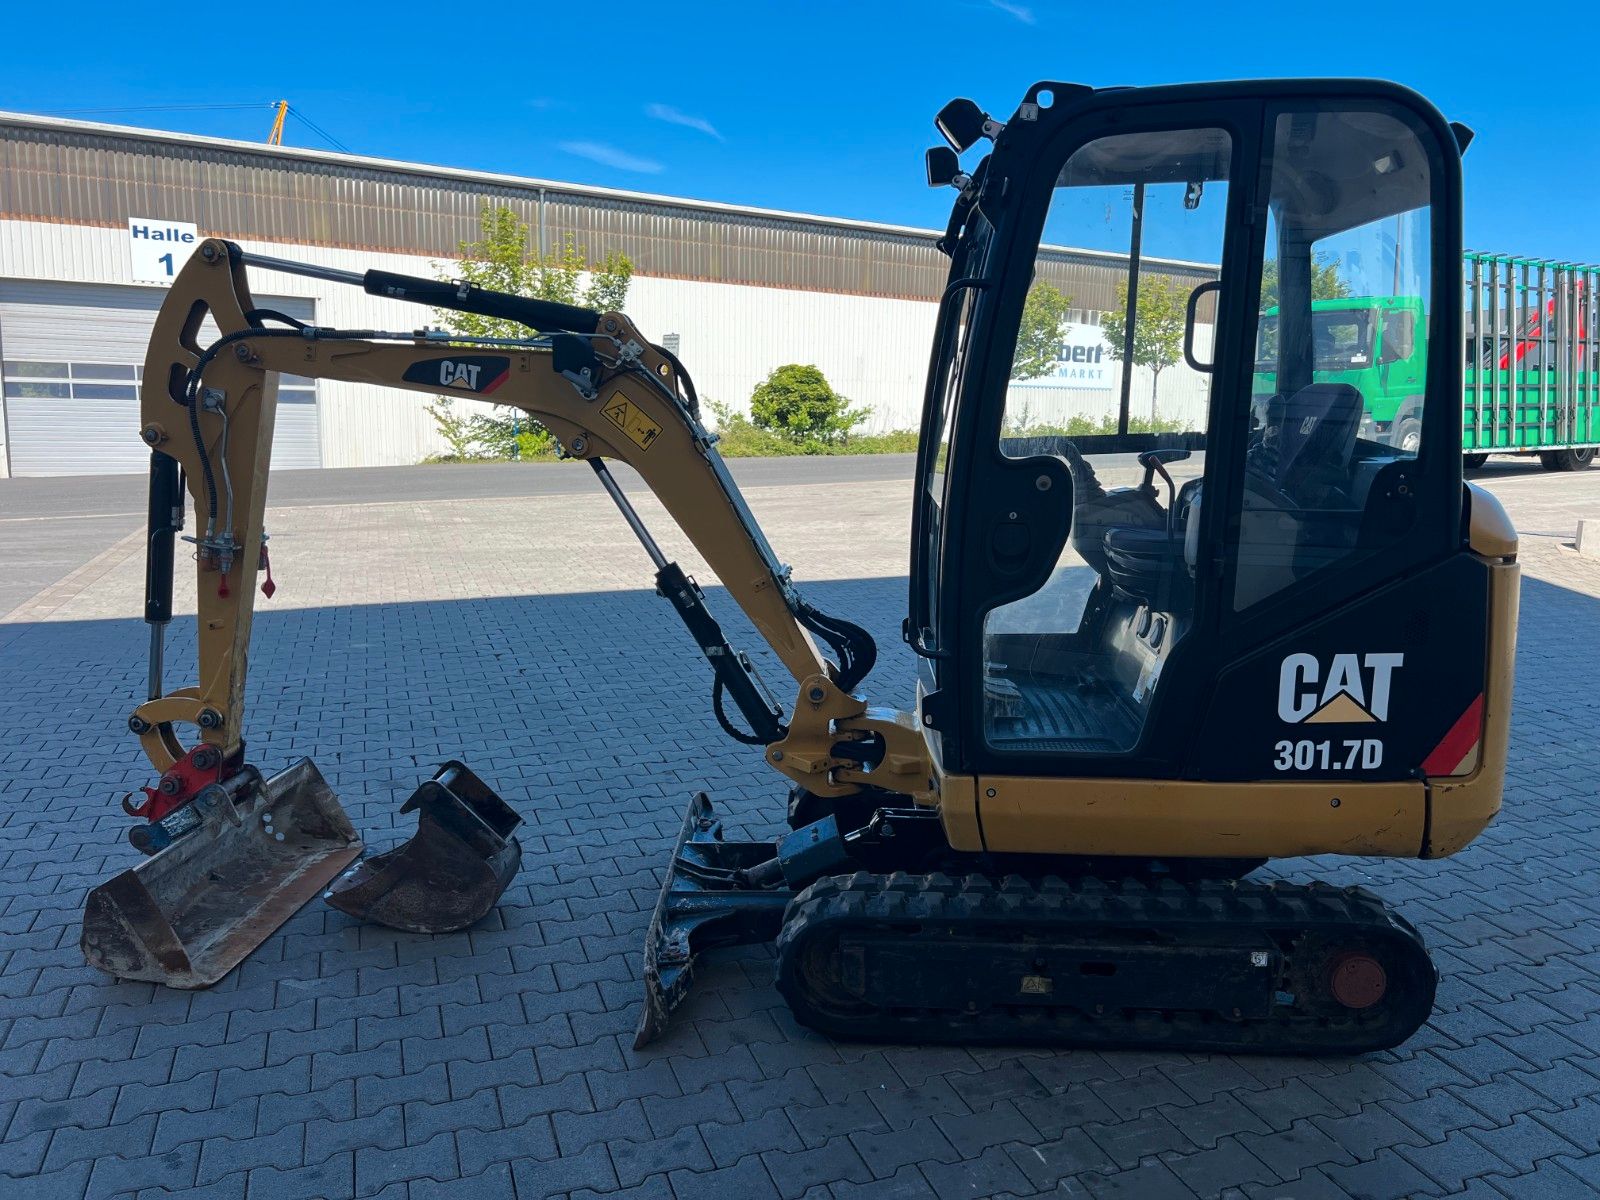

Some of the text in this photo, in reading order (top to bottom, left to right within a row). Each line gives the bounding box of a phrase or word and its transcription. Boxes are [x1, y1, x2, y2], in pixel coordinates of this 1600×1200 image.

[132, 225, 195, 243] Halle
[159, 252, 174, 276] 1
[1056, 343, 1104, 364] bert
[440, 360, 481, 390] CAT
[1049, 368, 1103, 380] MARKT
[1278, 652, 1405, 724] CAT
[1273, 739, 1384, 771] 301.7D
